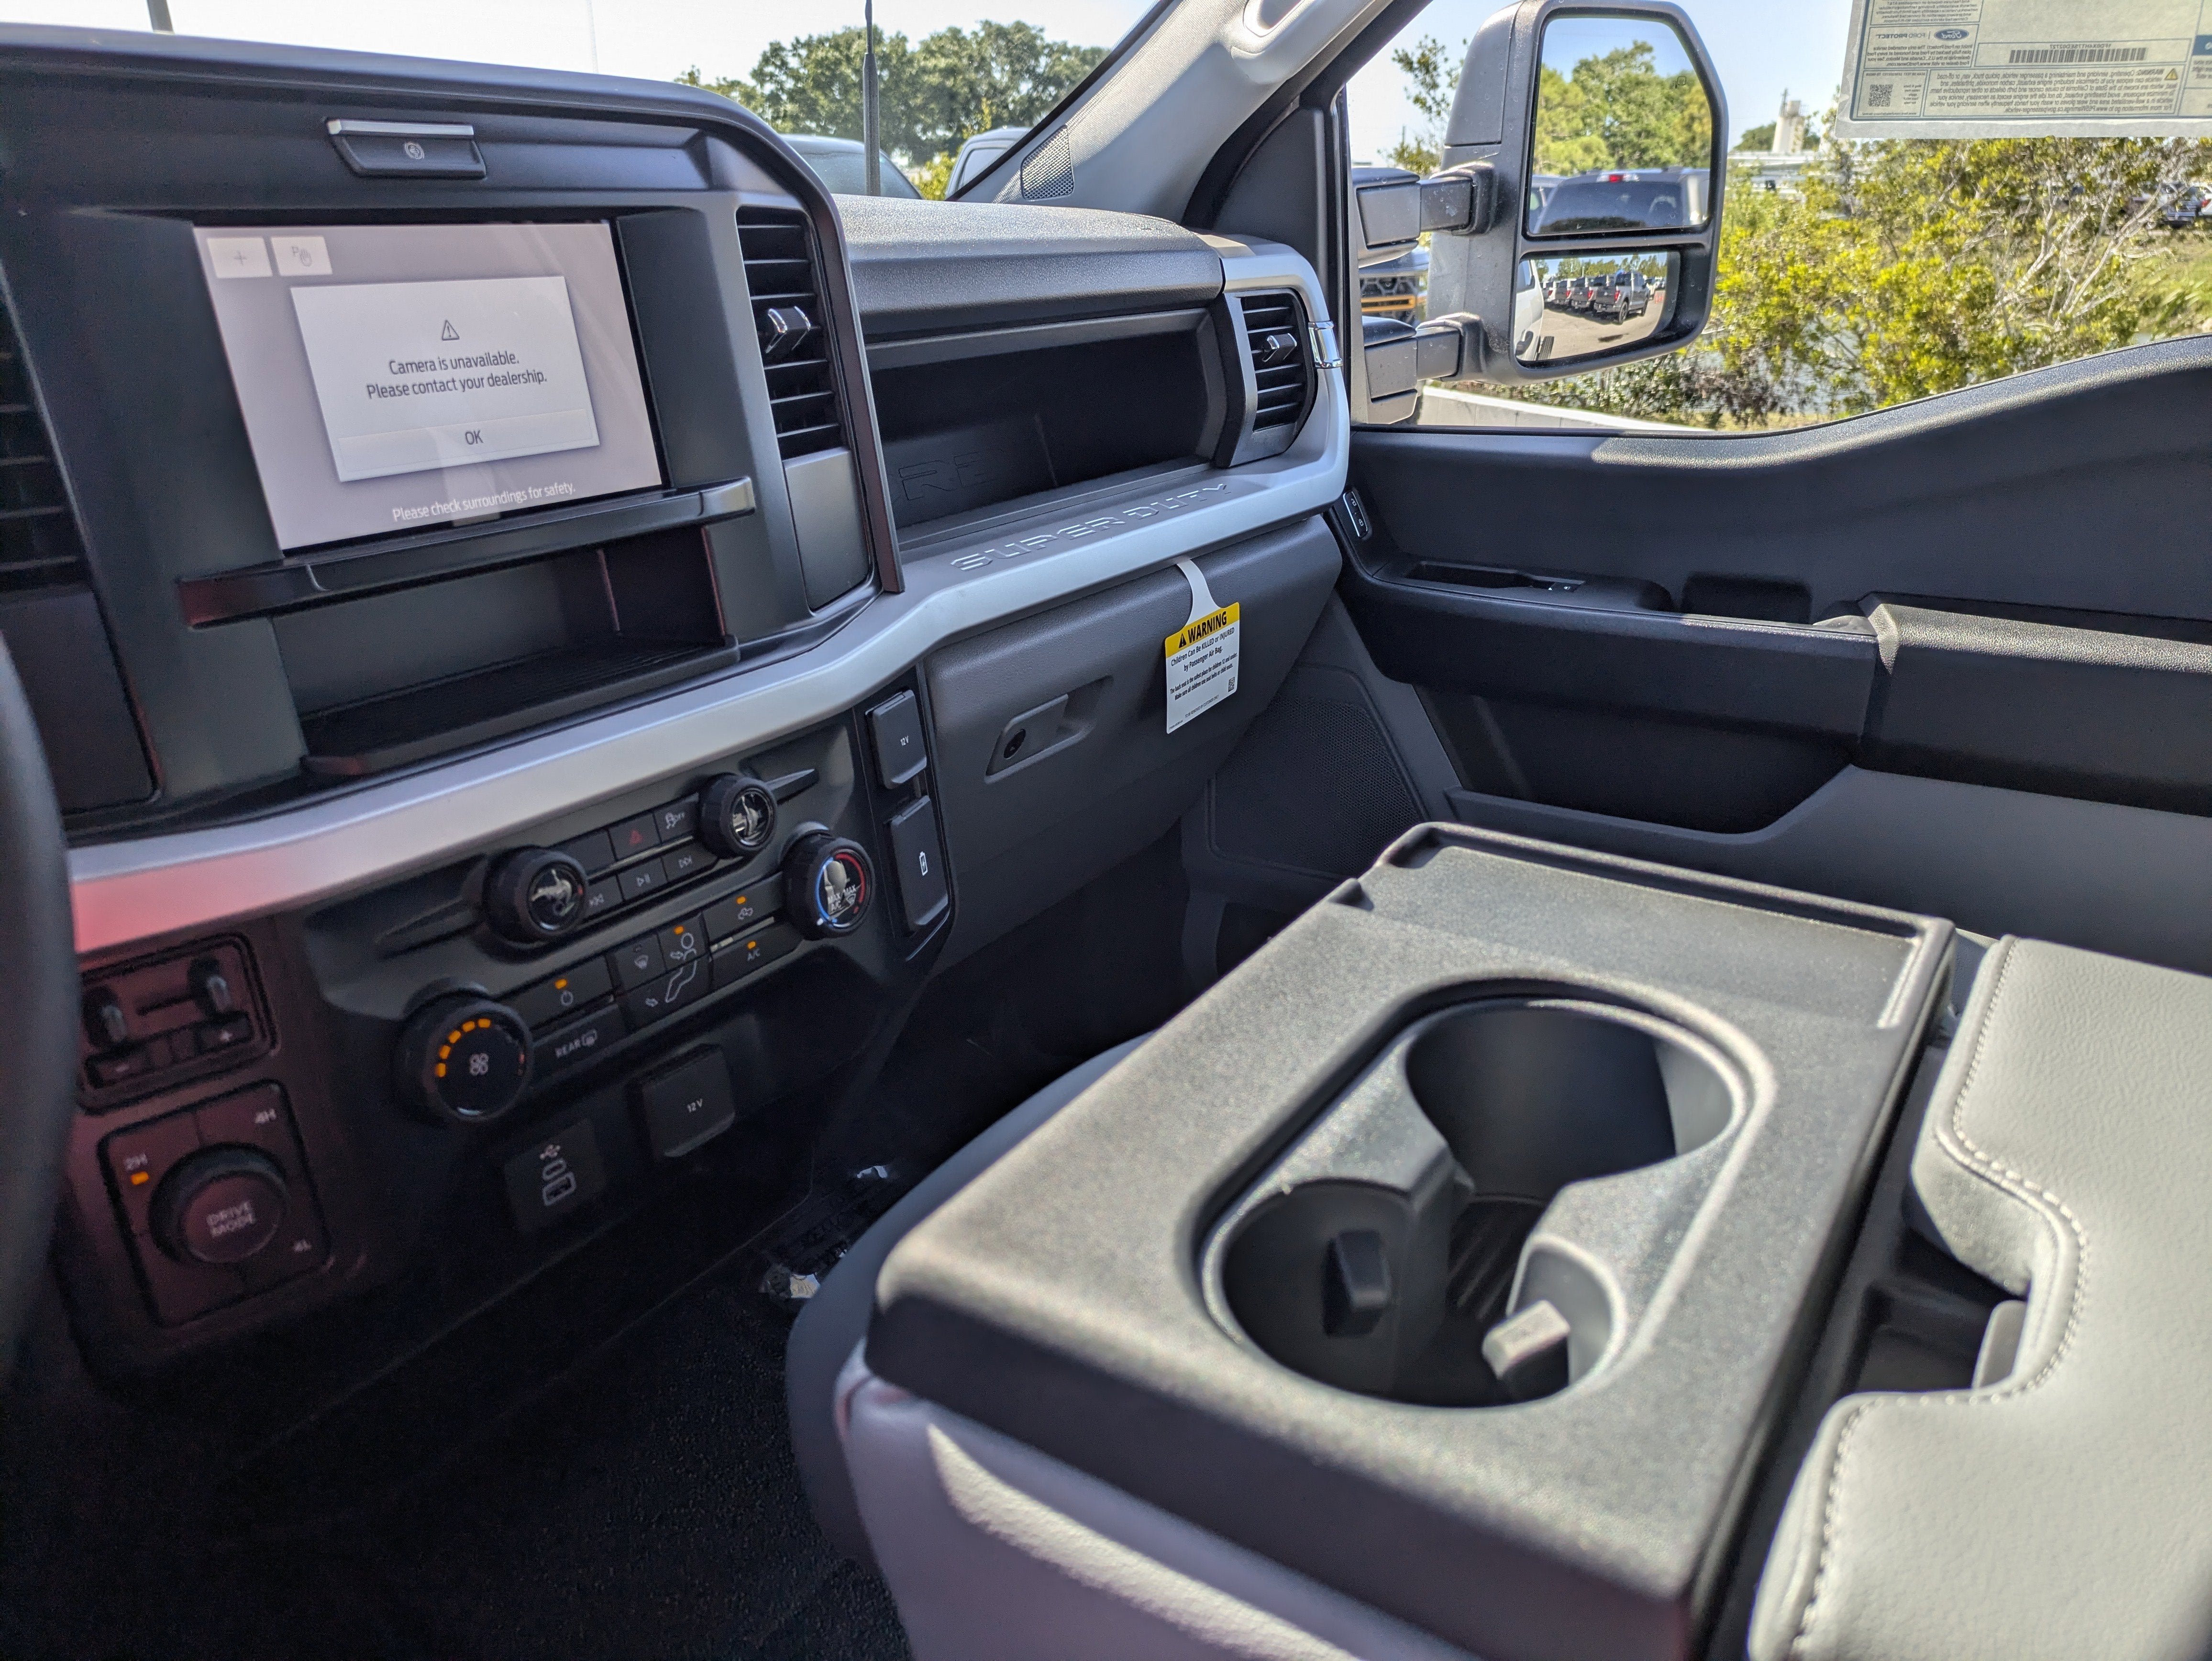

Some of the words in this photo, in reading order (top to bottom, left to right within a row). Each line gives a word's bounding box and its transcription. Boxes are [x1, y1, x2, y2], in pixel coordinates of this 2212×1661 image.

[389, 359, 436, 375] Camera
[438, 356, 448, 370] is
[450, 351, 520, 371] unavailable.
[366, 383, 410, 399] Please
[412, 377, 458, 395] contact
[459, 376, 486, 393] your
[487, 369, 547, 387] dealership.
[465, 430, 484, 445] OK
[392, 505, 430, 522] Please
[431, 499, 461, 515] check
[463, 489, 527, 510] surroundings
[529, 486, 543, 499] for
[544, 482, 575, 497] safety.
[951, 517, 1126, 572] SUPER
[1123, 483, 1231, 520] DUTY
[1188, 611, 1227, 643] WARNING
[1171, 653, 1187, 666] Children
[1202, 638, 1214, 650] KILLED
[1219, 627, 1235, 640] INJURED
[1189, 653, 1208, 668] Passenger
[900, 735, 909, 746] 12V
[687, 1098, 703, 1113] 12V
